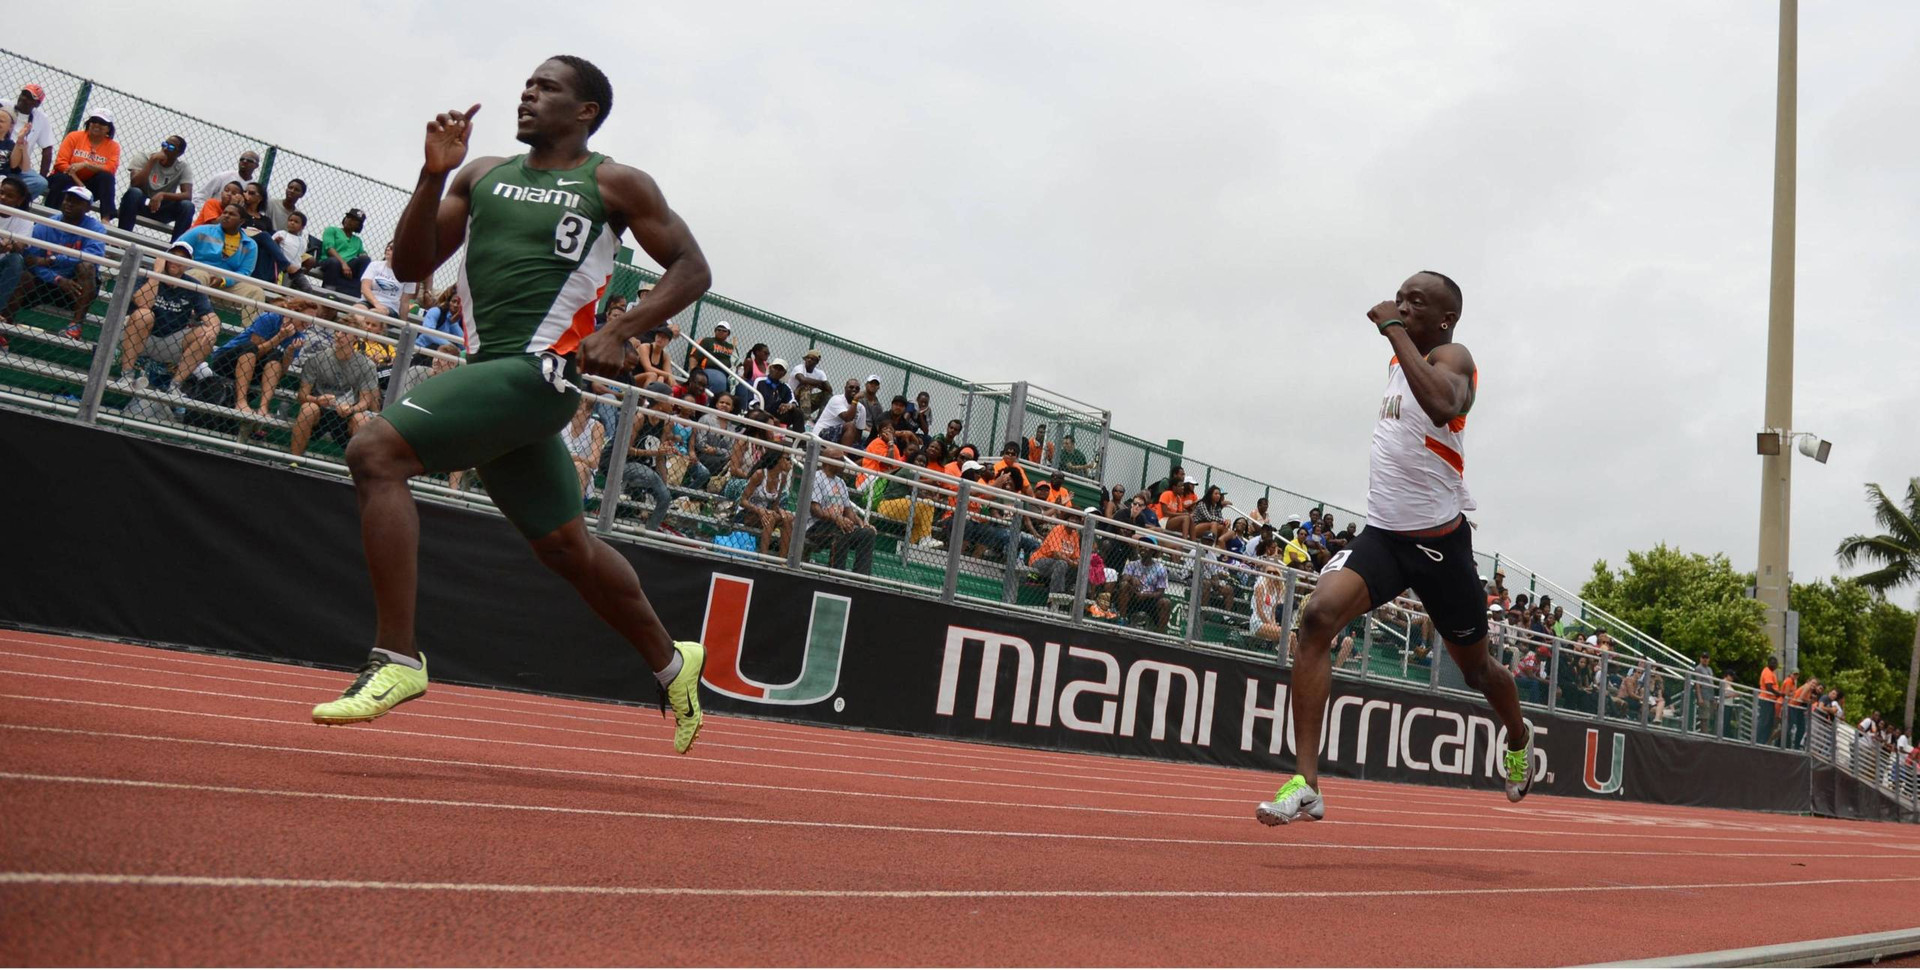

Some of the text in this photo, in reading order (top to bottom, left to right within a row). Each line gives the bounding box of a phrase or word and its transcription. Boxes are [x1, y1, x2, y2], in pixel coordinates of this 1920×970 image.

[493, 182, 580, 208] MIAMI
[556, 216, 583, 254] 3
[1322, 552, 1345, 572] 2
[700, 572, 852, 706] U
[1583, 727, 1625, 794] U
